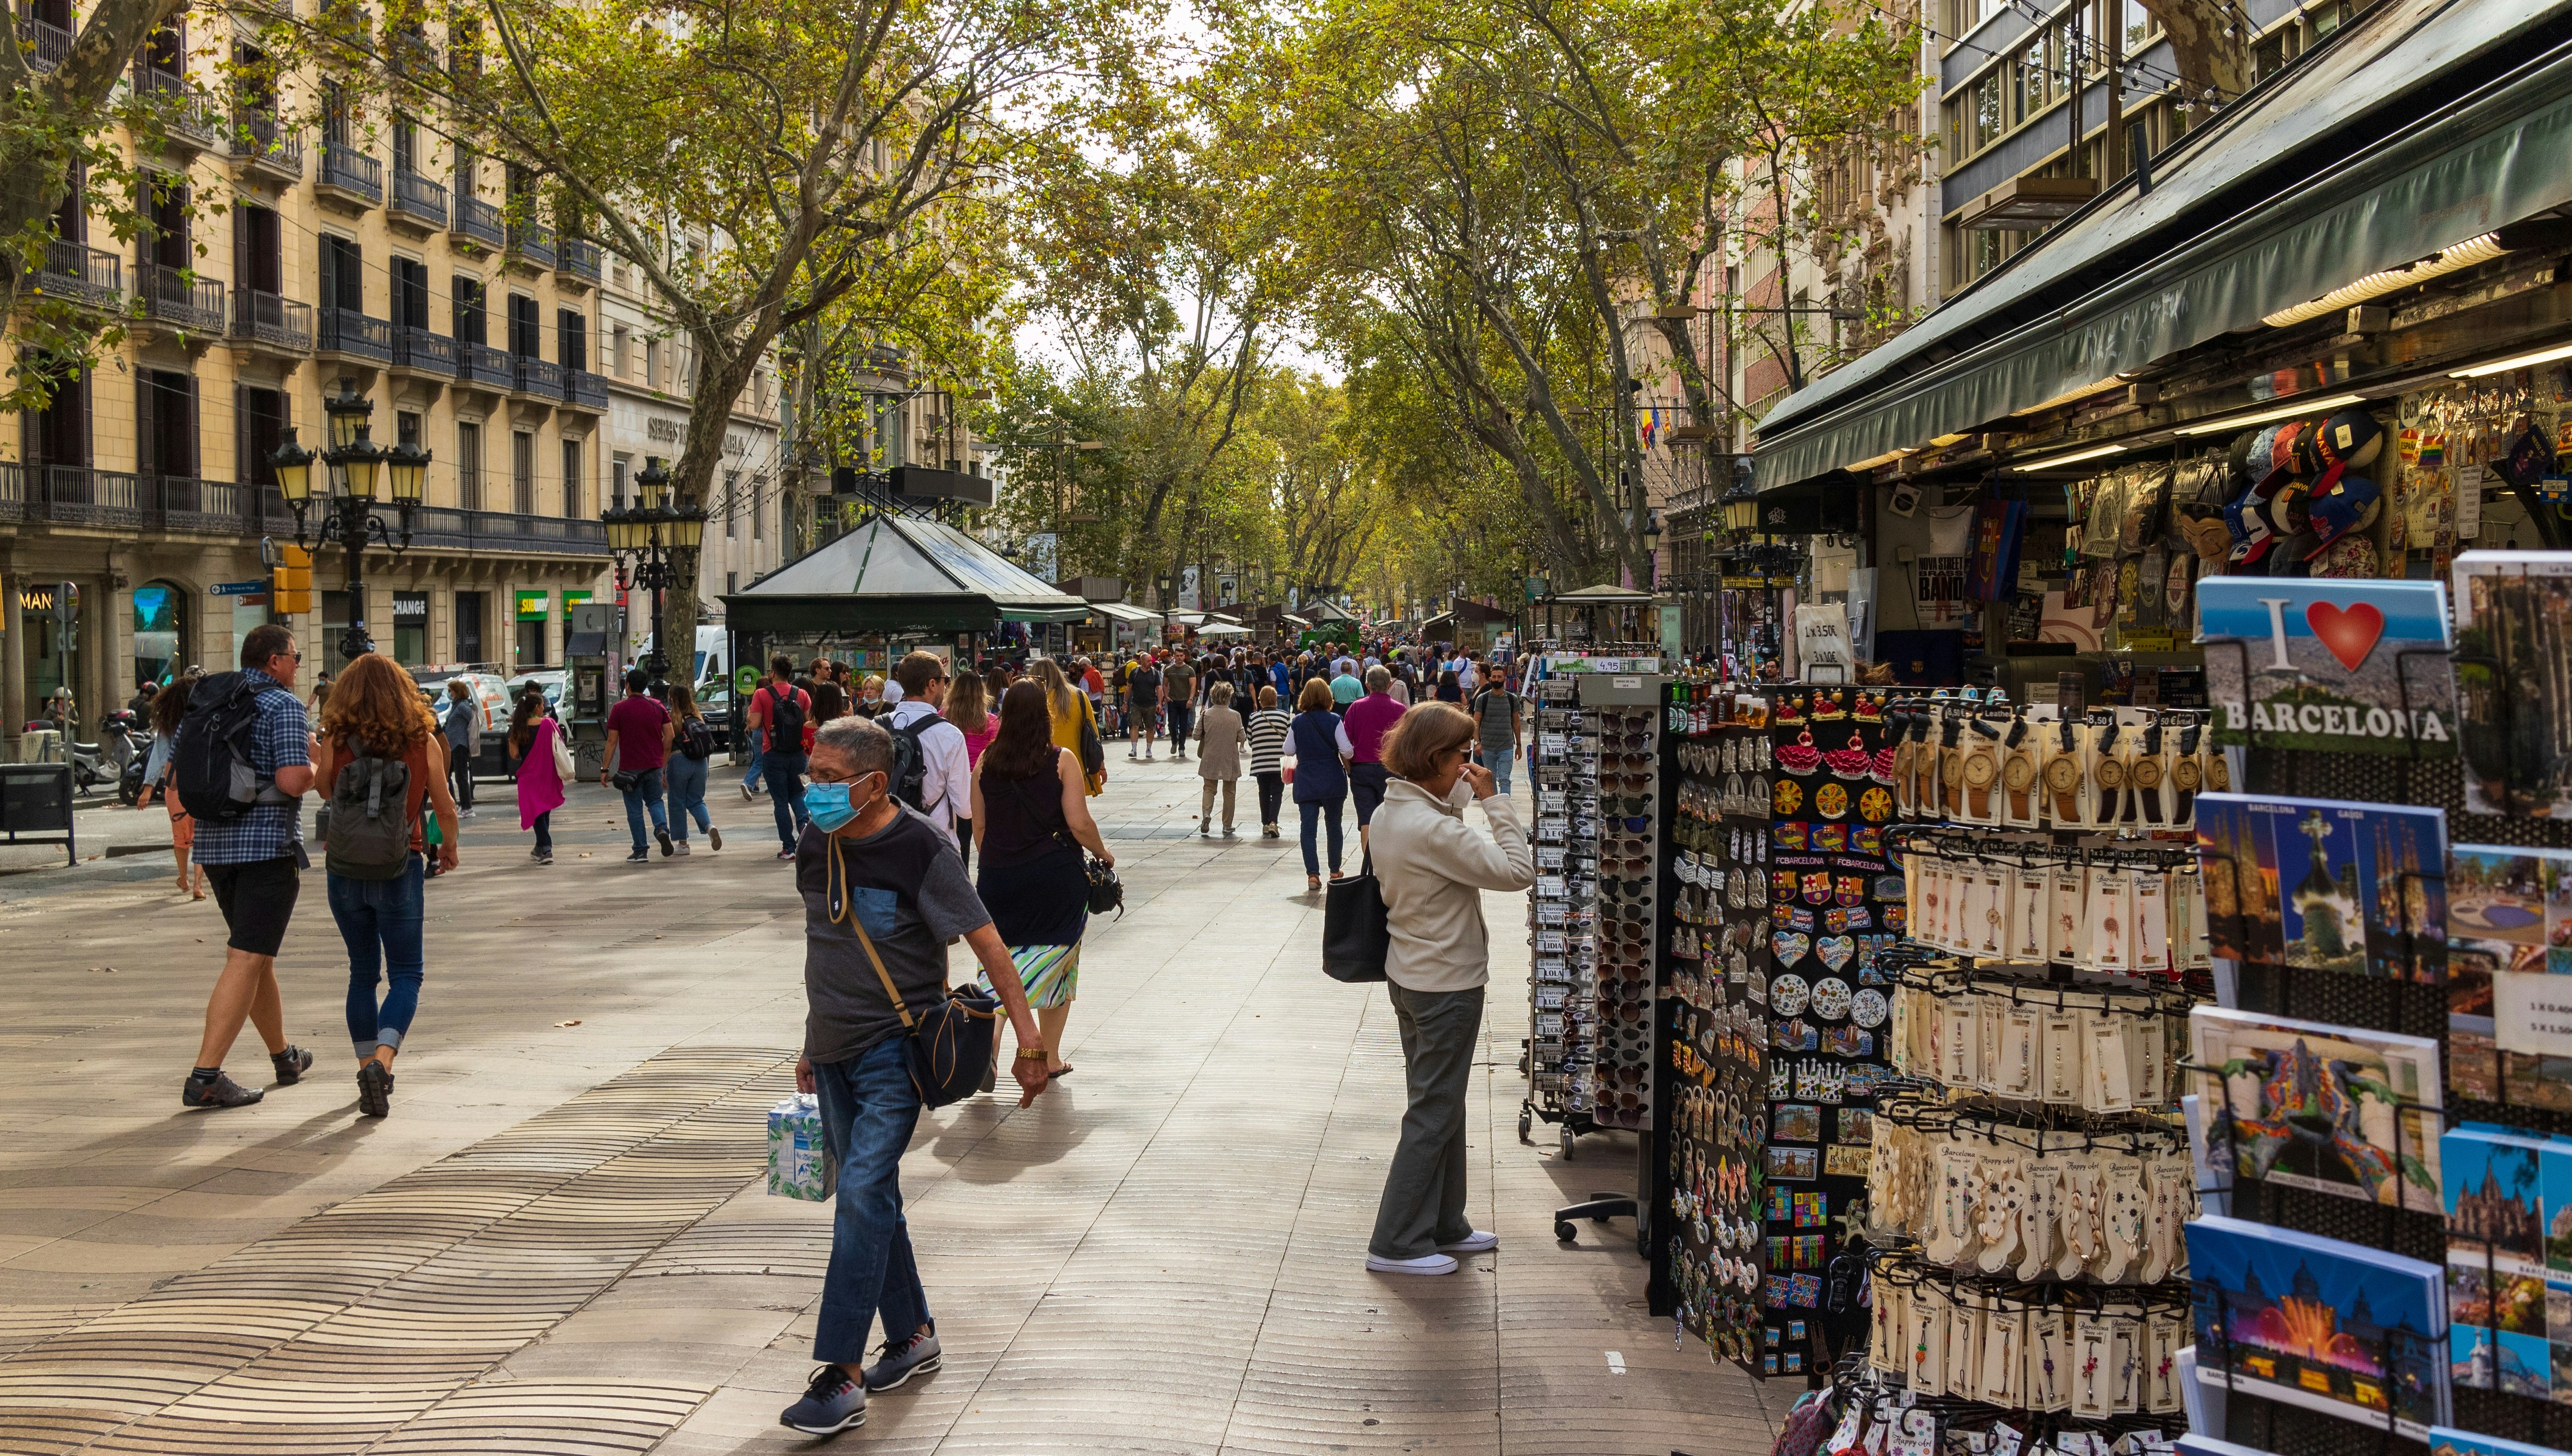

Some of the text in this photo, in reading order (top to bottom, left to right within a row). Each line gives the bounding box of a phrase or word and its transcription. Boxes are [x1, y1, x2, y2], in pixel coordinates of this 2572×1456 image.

[2404, 398, 2419, 420] BCN
[648, 416, 679, 441] SERHS
[2531, 435, 2541, 451] MESSI
[1919, 557, 1964, 570] NOVA STREET
[1919, 576, 1963, 601] BAND
[20, 593, 54, 610] MAN
[522, 597, 549, 614] SUBWAY
[707, 605, 726, 614] SER
[1805, 625, 1837, 638] 1 x 3.50€
[2257, 598, 2300, 670] I
[1813, 651, 1819, 662] 3
[1823, 651, 1838, 663] 10€
[1600, 661, 1618, 671] 4,95
[2089, 714, 2107, 725] 8,50
[2170, 716, 2176, 725] €
[2224, 700, 2449, 742] BARCELONA
[2248, 803, 2296, 815] BARCELONA
[1837, 859, 1885, 871] FCBARCELONA
[2018, 869, 2047, 878] Barcelona
[2054, 870, 2081, 880] Barcelona
[2096, 874, 2127, 883] Barcelona
[2134, 876, 2162, 886] Barcelona
[1790, 920, 1812, 930] BARÇA!
[1779, 944, 1807, 954] Barcelona
[1825, 948, 1853, 959] Barcelona
[1946, 998, 1963, 1007] Happy
[2006, 1005, 2036, 1014] Barcelona
[2046, 1012, 2064, 1021] Happy
[2089, 1019, 2106, 1028] Happy
[1941, 1146, 1976, 1158] Barcelona
[1979, 1155, 2015, 1166] Happy Art
[2066, 1160, 2086, 1171] Happy
[2026, 1163, 2058, 1173] Barcelona
[2109, 1162, 2139, 1172] Barcelona
[2154, 1164, 2183, 1175] Barcelona
[1872, 1277, 1895, 1290] Barcelona
[1910, 1299, 1937, 1312] Barcelona
[1990, 1311, 2019, 1324] Barcelona
[2112, 1318, 2138, 1328] Barcelona
[2034, 1317, 2059, 1331] Barcelona
[2078, 1321, 2109, 1331] Barcelona
[2151, 1319, 2177, 1329] Barcelona
[2206, 1370, 2245, 1385] BARCONA
[1892, 1434, 1932, 1447] Happy Art
